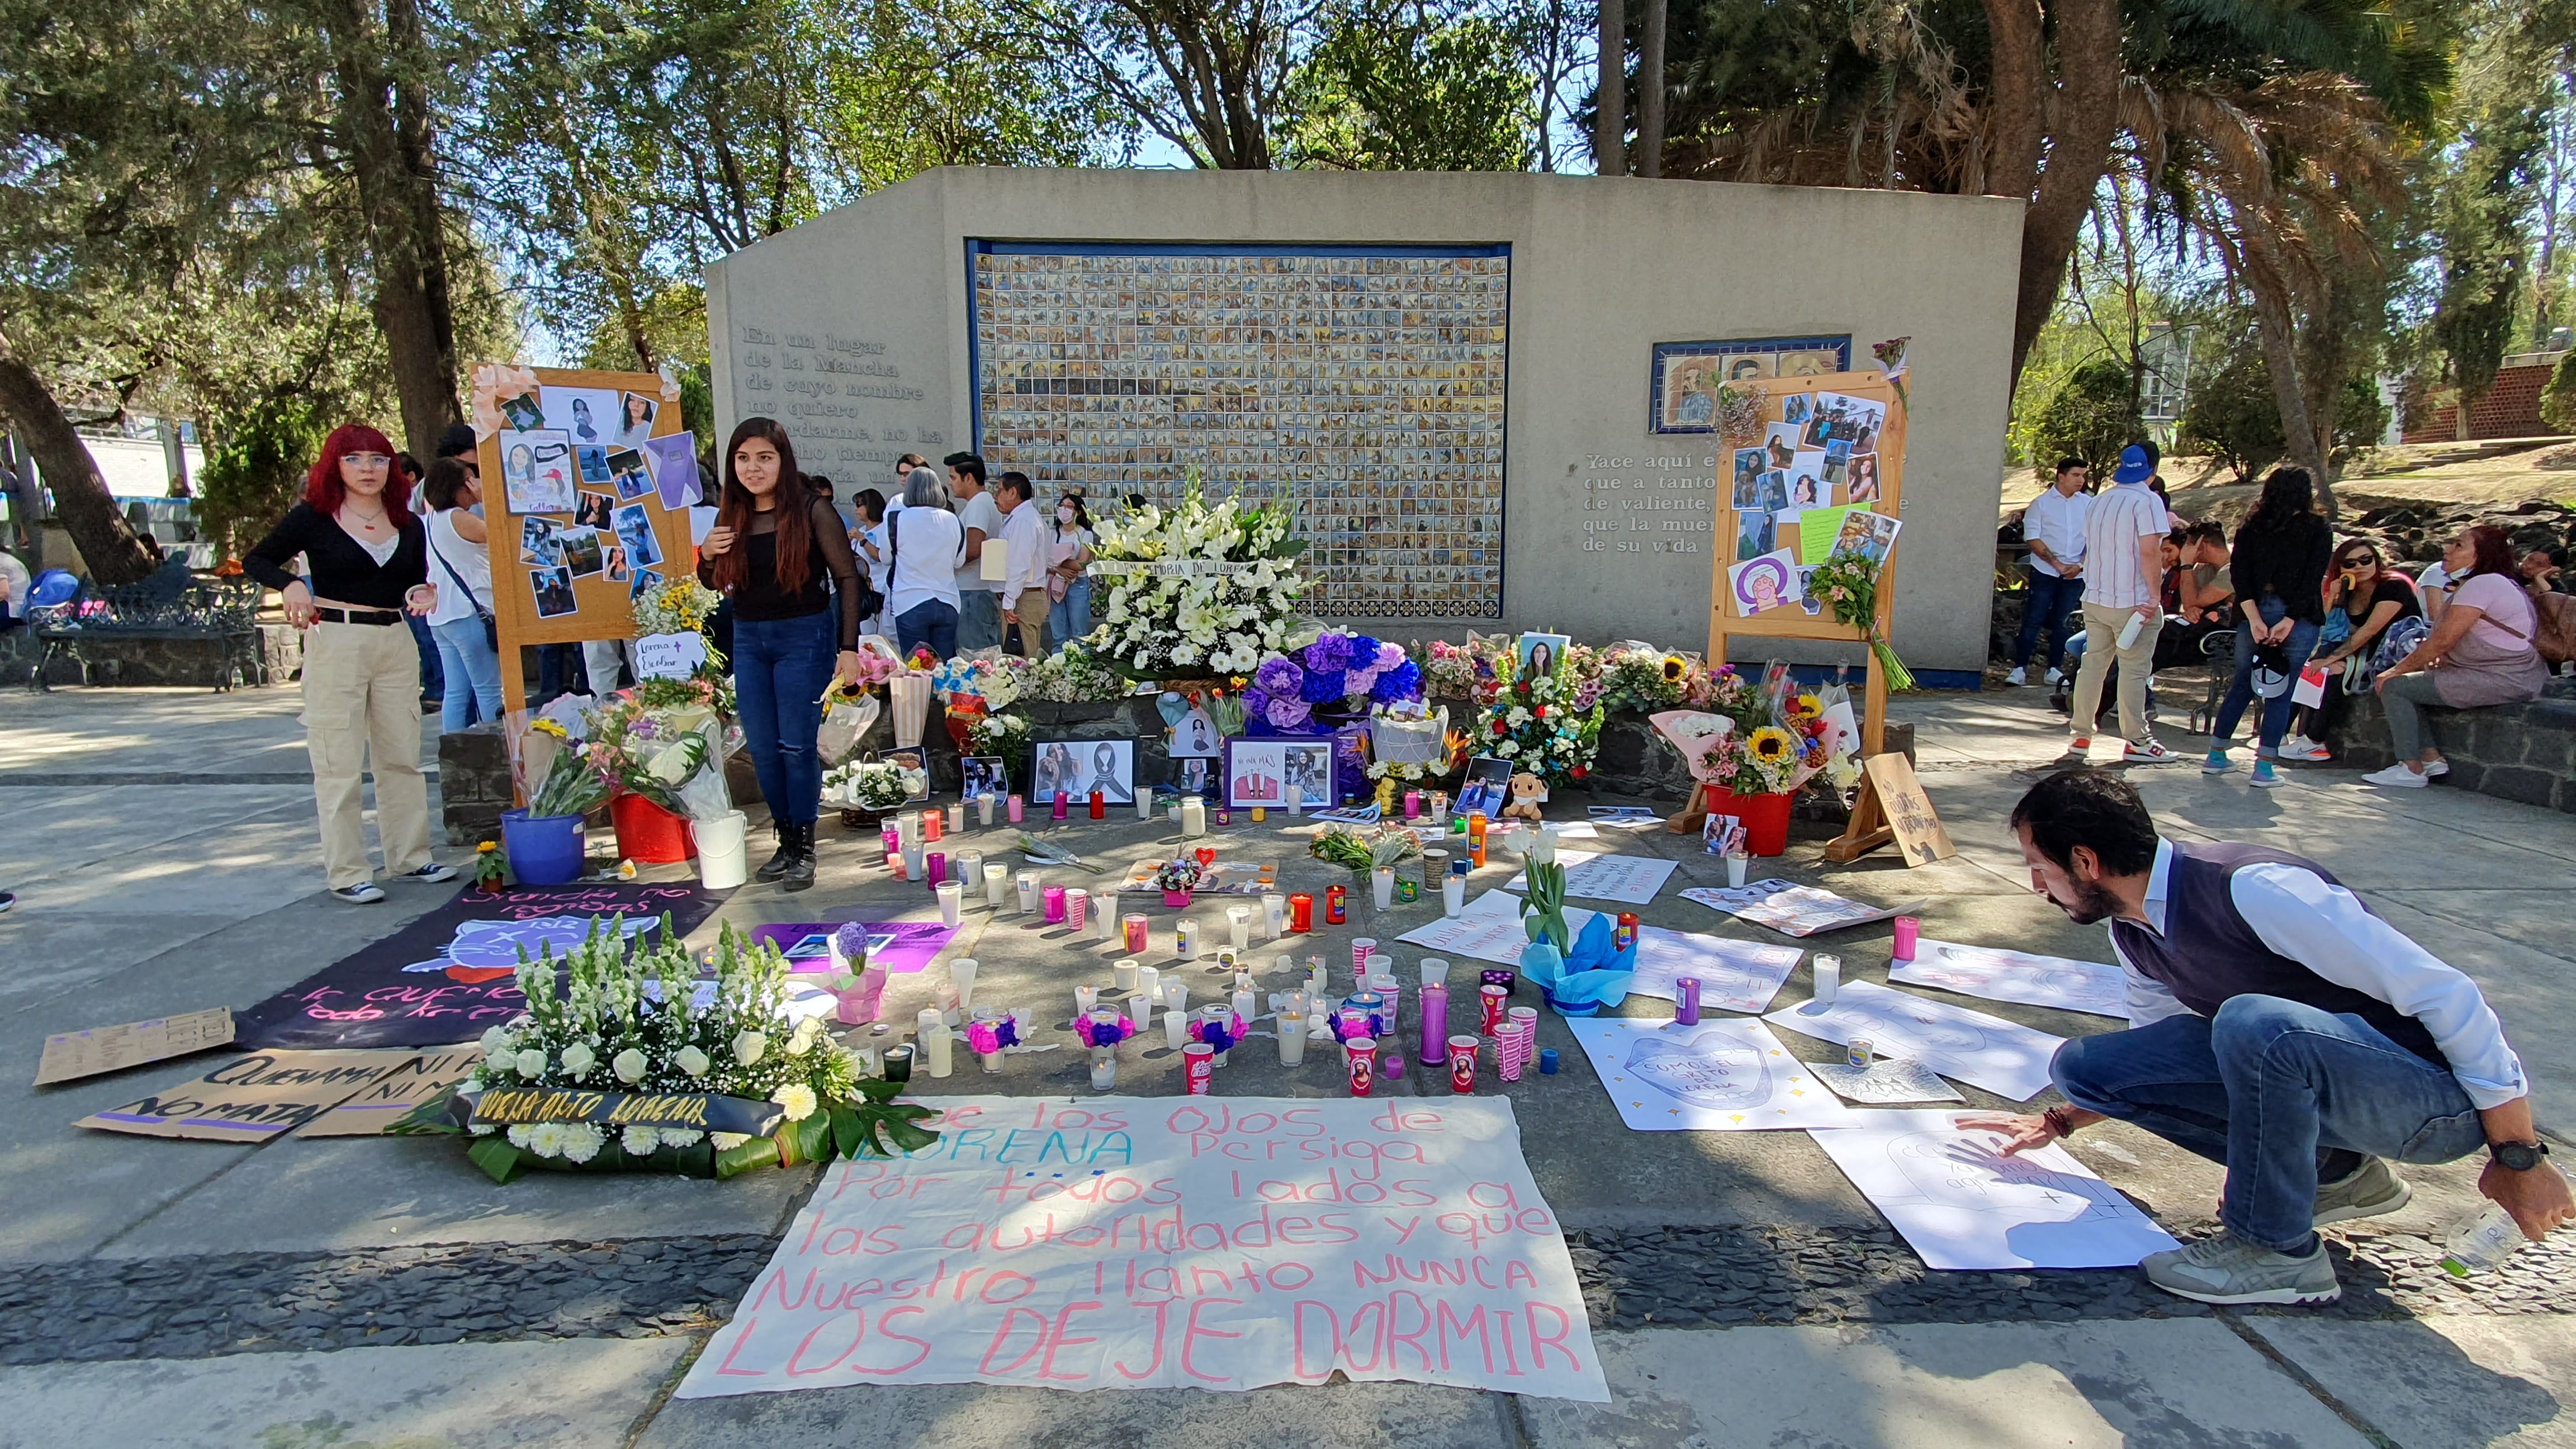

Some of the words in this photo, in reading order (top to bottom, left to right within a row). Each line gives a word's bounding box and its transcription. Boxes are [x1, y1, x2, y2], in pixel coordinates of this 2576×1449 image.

[742, 326, 776, 345] En
[785, 335, 816, 349] un
[825, 334, 887, 357] lugar
[744, 351, 771, 368] de
[782, 354, 804, 370] la
[814, 356, 899, 377] Mancha
[745, 373, 773, 390] de
[784, 379, 836, 398] cuyo
[845, 382, 924, 400] nombre
[747, 401, 777, 414] no
[788, 402, 858, 419] quiero
[883, 431, 908, 442] no
[917, 427, 943, 444] ha
[1585, 454, 1634, 470] Yace
[1645, 453, 1692, 471] aquí
[1584, 478, 1622, 493] que
[1633, 478, 1645, 489] a
[1658, 475, 1716, 489] tanto
[1583, 497, 1608, 510] de
[1621, 496, 1712, 513] valiente,
[1583, 518, 1620, 534] que
[1630, 517, 1650, 531] la
[1583, 537, 1606, 552] de
[1616, 541, 1641, 552] su
[1651, 538, 1698, 552] vida
[1192, 562, 1205, 574] DE
[1644, 1059, 1711, 1073] SOMOS
[1715, 1059, 1740, 1067] EL
[1671, 1068, 1730, 1079] GRITO
[1675, 1082, 1743, 1092] LORENA
[111, 1096, 204, 1116] NO
[195, 1102, 320, 1125] MATA
[1031, 1101, 1129, 1131] los
[1370, 1100, 1446, 1133] de
[831, 1162, 950, 1201] Por
[984, 1166, 1182, 1205] todos
[1230, 1167, 1439, 1207] lados
[1466, 1181, 1519, 1211] a
[797, 1209, 906, 1257] las
[940, 1202, 1360, 1256] autoridades
[1384, 1215, 1422, 1246] y
[1434, 1207, 1554, 1251] que
[751, 1258, 1037, 1312] Nuestro
[1094, 1258, 1314, 1299] llanto
[1351, 1252, 1537, 1290] NUNCA
[714, 1304, 932, 1379] LOS
[977, 1295, 1244, 1382] DEJE
[1292, 1289, 1581, 1380] DORMIR
